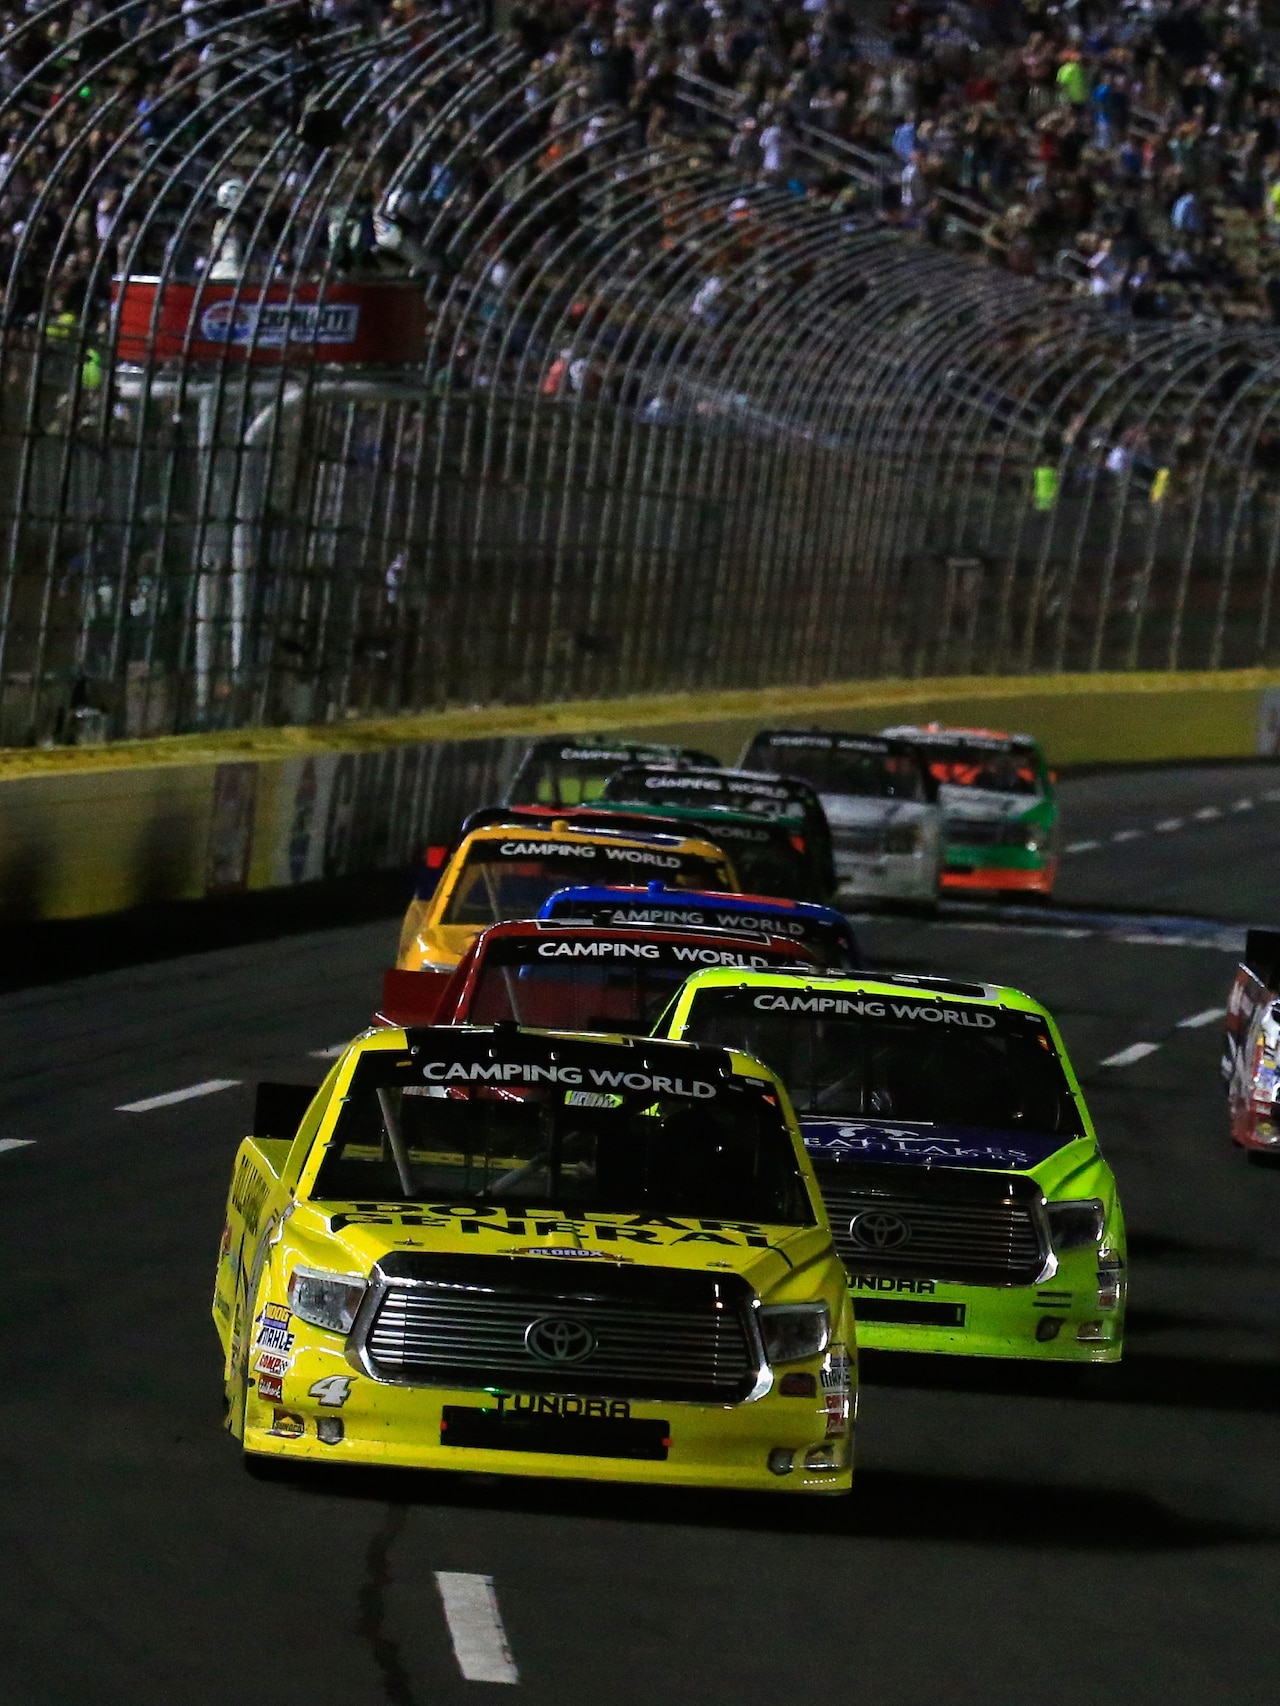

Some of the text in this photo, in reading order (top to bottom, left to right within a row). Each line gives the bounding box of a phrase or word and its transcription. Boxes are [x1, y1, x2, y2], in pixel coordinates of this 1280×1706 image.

[500, 842, 683, 870] CAMPING WORLD
[716, 913, 805, 936] WORLD
[537, 942, 769, 968] CAMPING WORLD
[753, 994, 997, 1029] CAMPING WORLD
[422, 1062, 583, 1085] CAMPING
[588, 1068, 718, 1100] WORLD
[331, 1212, 790, 1255] GENERAL
[308, 1374, 358, 1408] 4
[490, 1393, 630, 1419] TUNDRA
